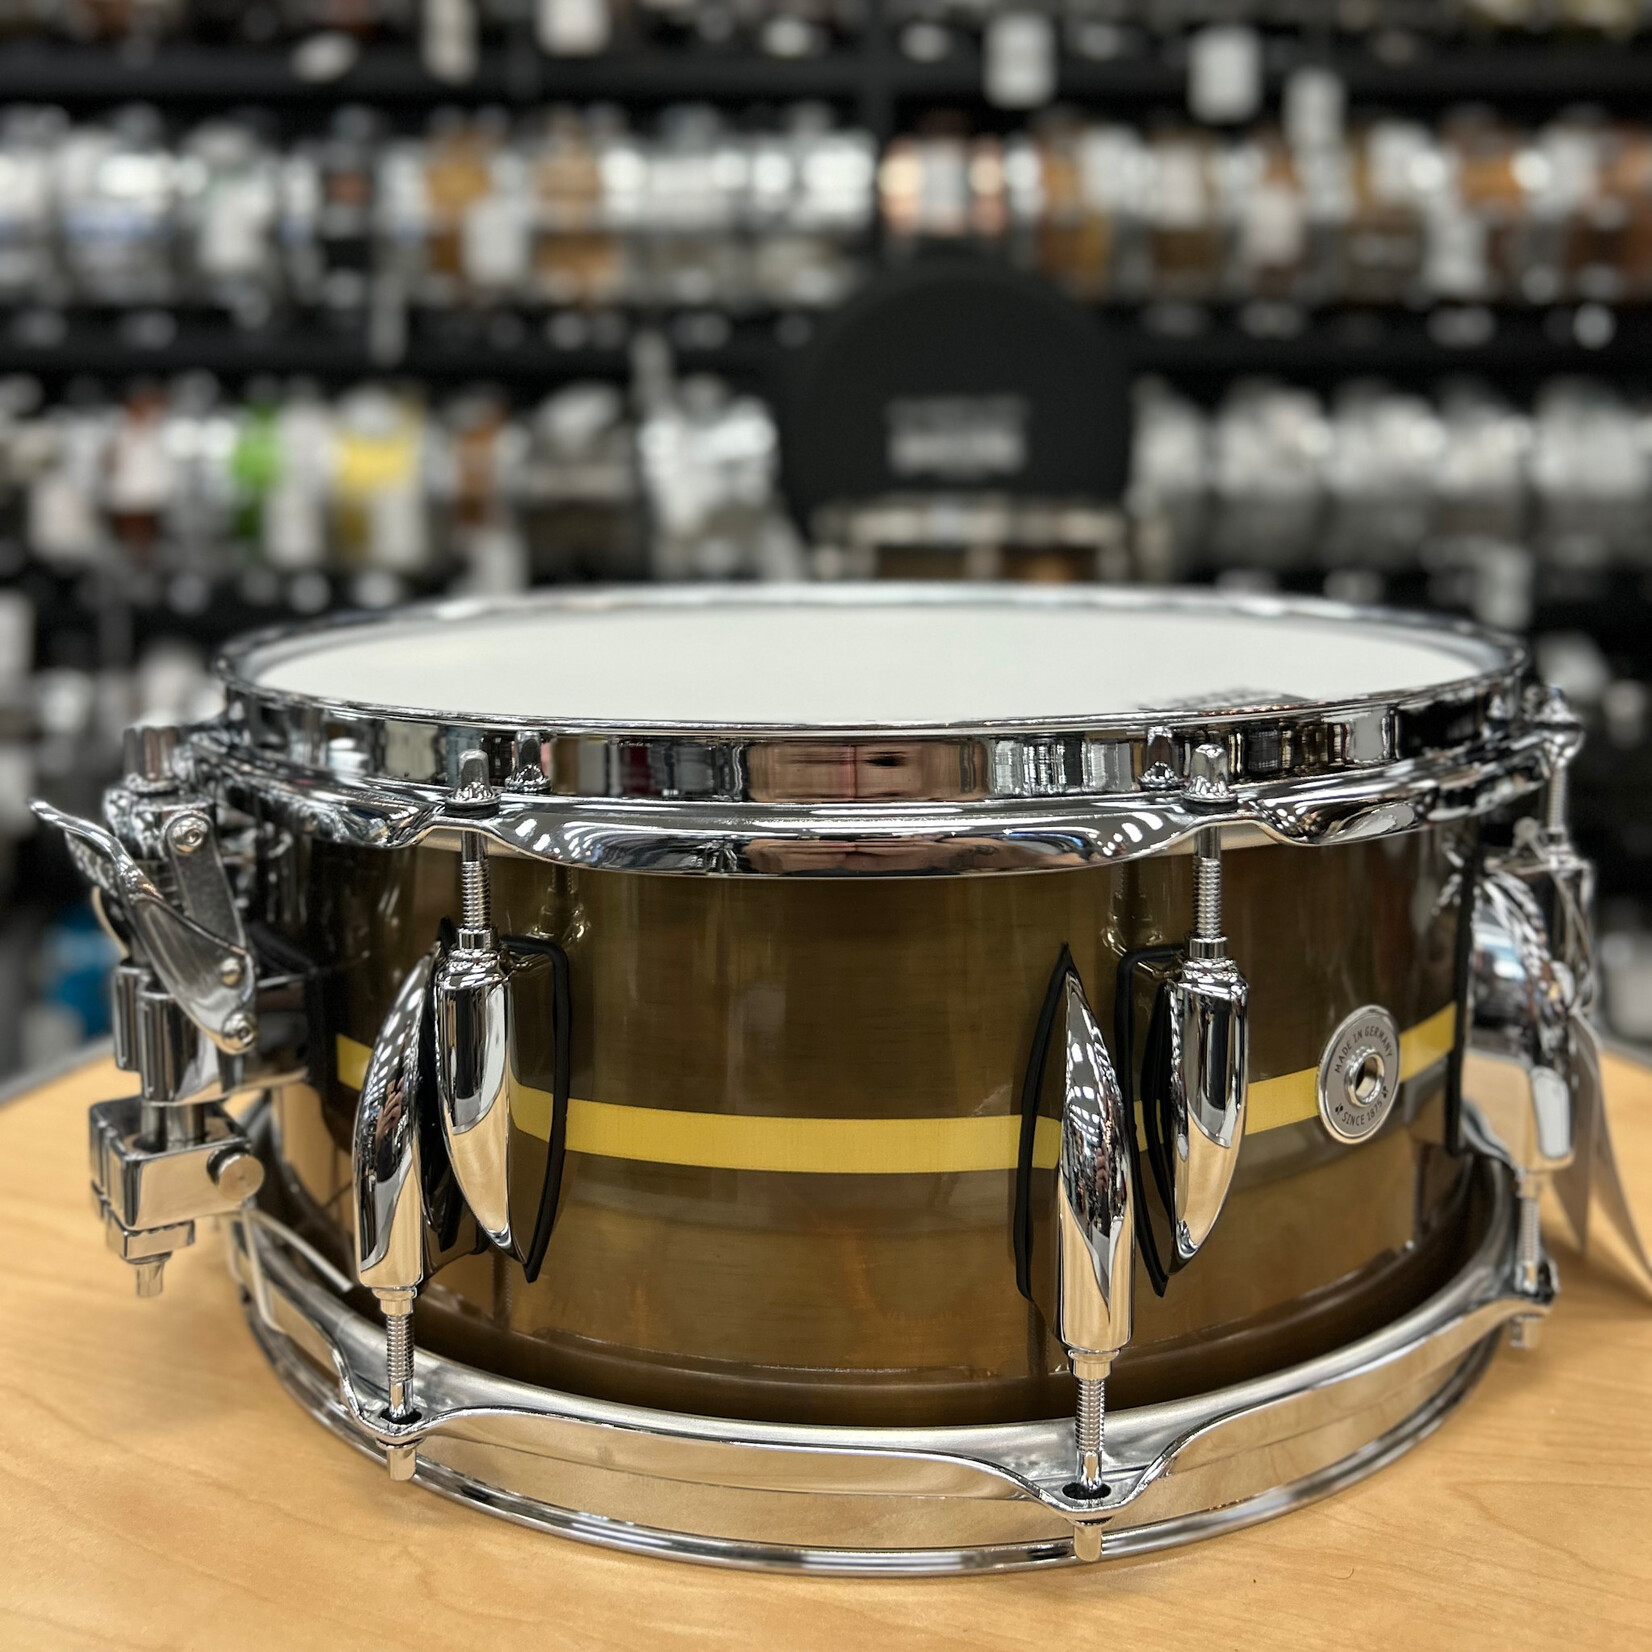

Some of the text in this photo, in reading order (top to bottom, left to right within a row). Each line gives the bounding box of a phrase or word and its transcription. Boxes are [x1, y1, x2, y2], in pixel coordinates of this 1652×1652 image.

[1334, 1025, 1392, 1073] MADE IN GERMANY
[1342, 1100, 1383, 1126] SINCE 1875
